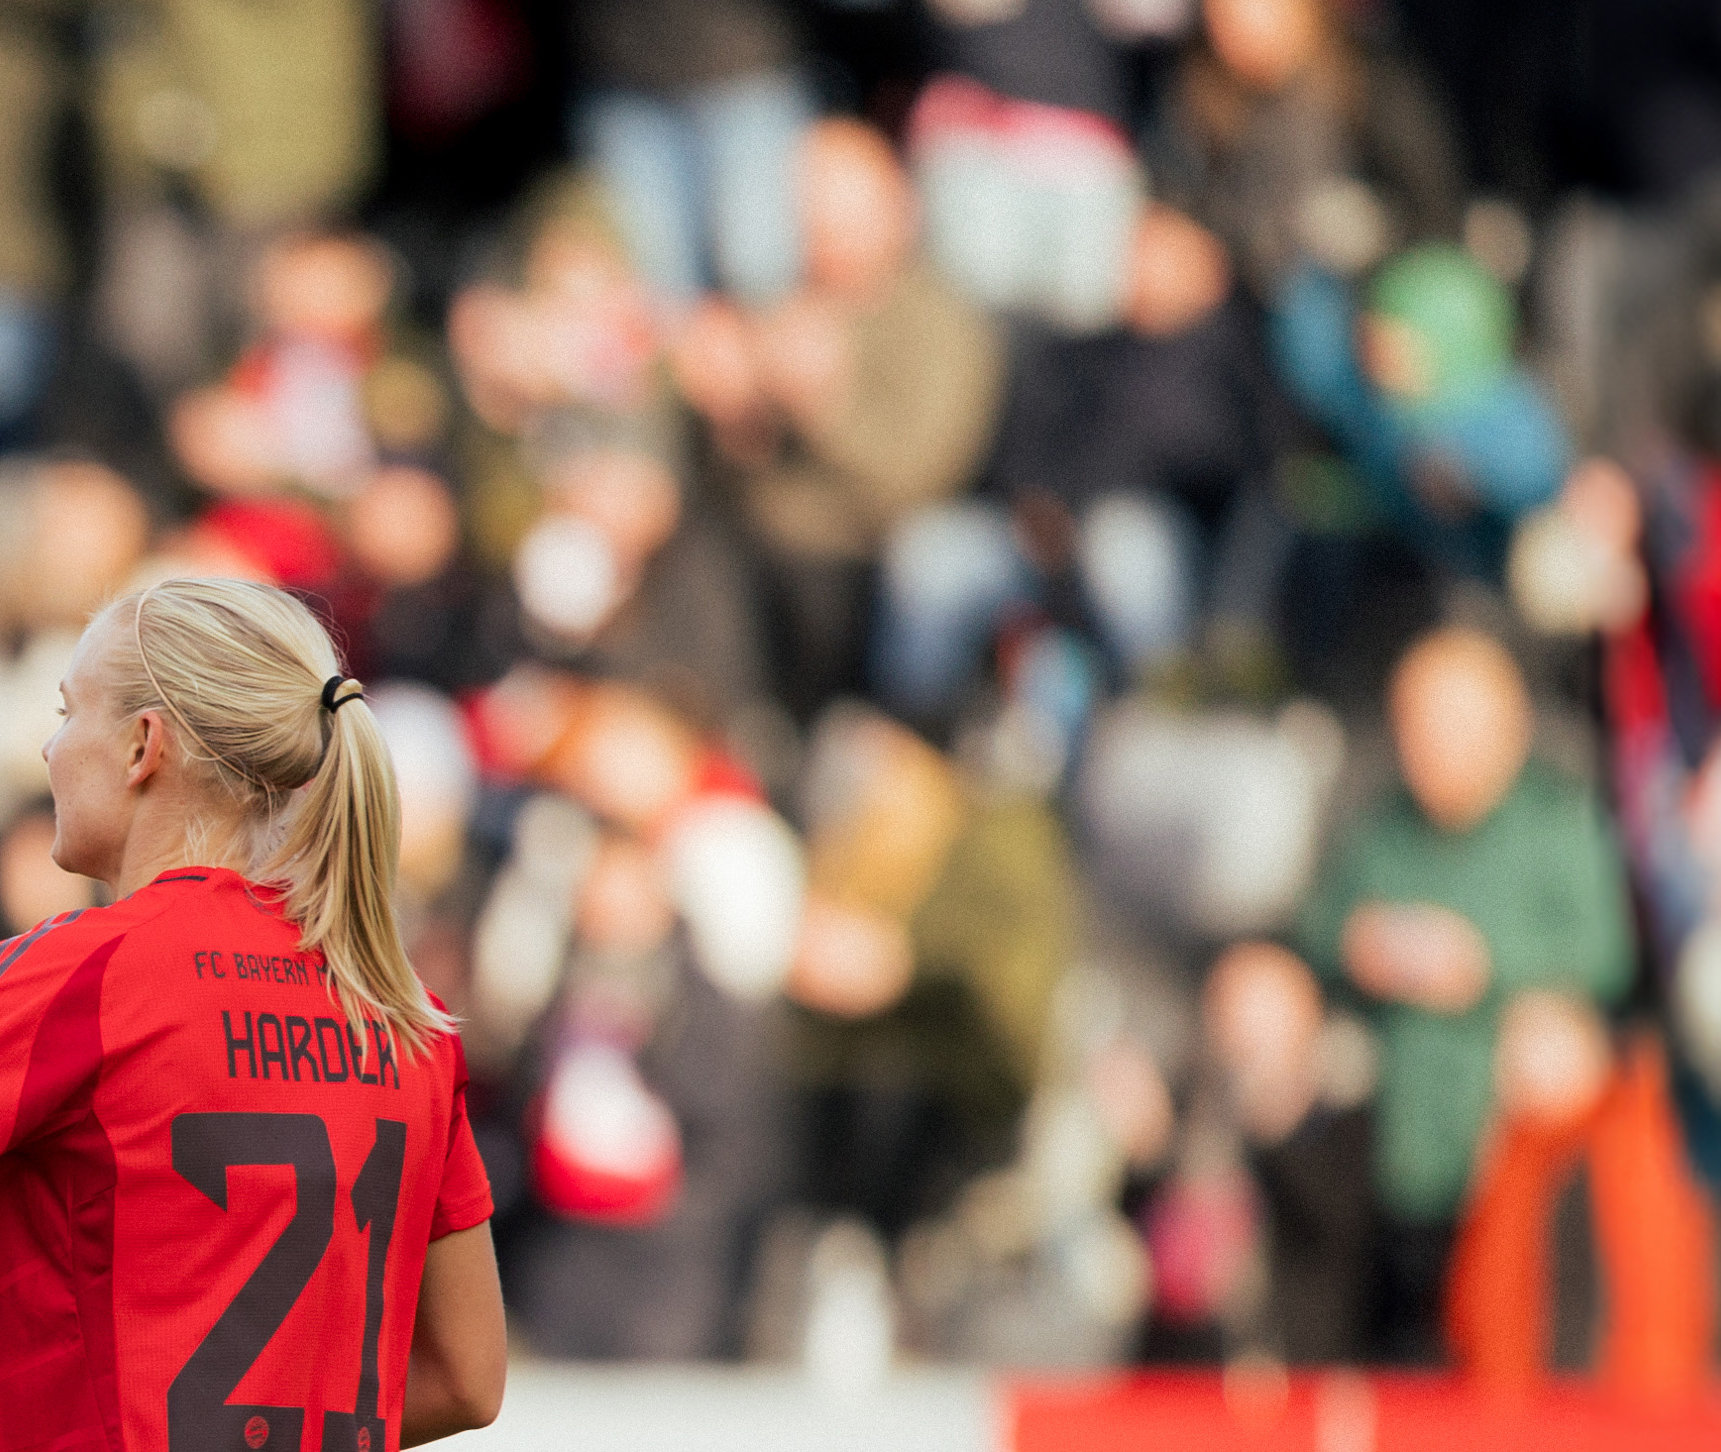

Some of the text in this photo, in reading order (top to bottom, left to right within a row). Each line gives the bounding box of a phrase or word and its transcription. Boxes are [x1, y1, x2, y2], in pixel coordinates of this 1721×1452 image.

[194, 951, 226, 979] FC
[233, 952, 309, 986] BAYERN
[221, 1010, 400, 1090] HARDER
